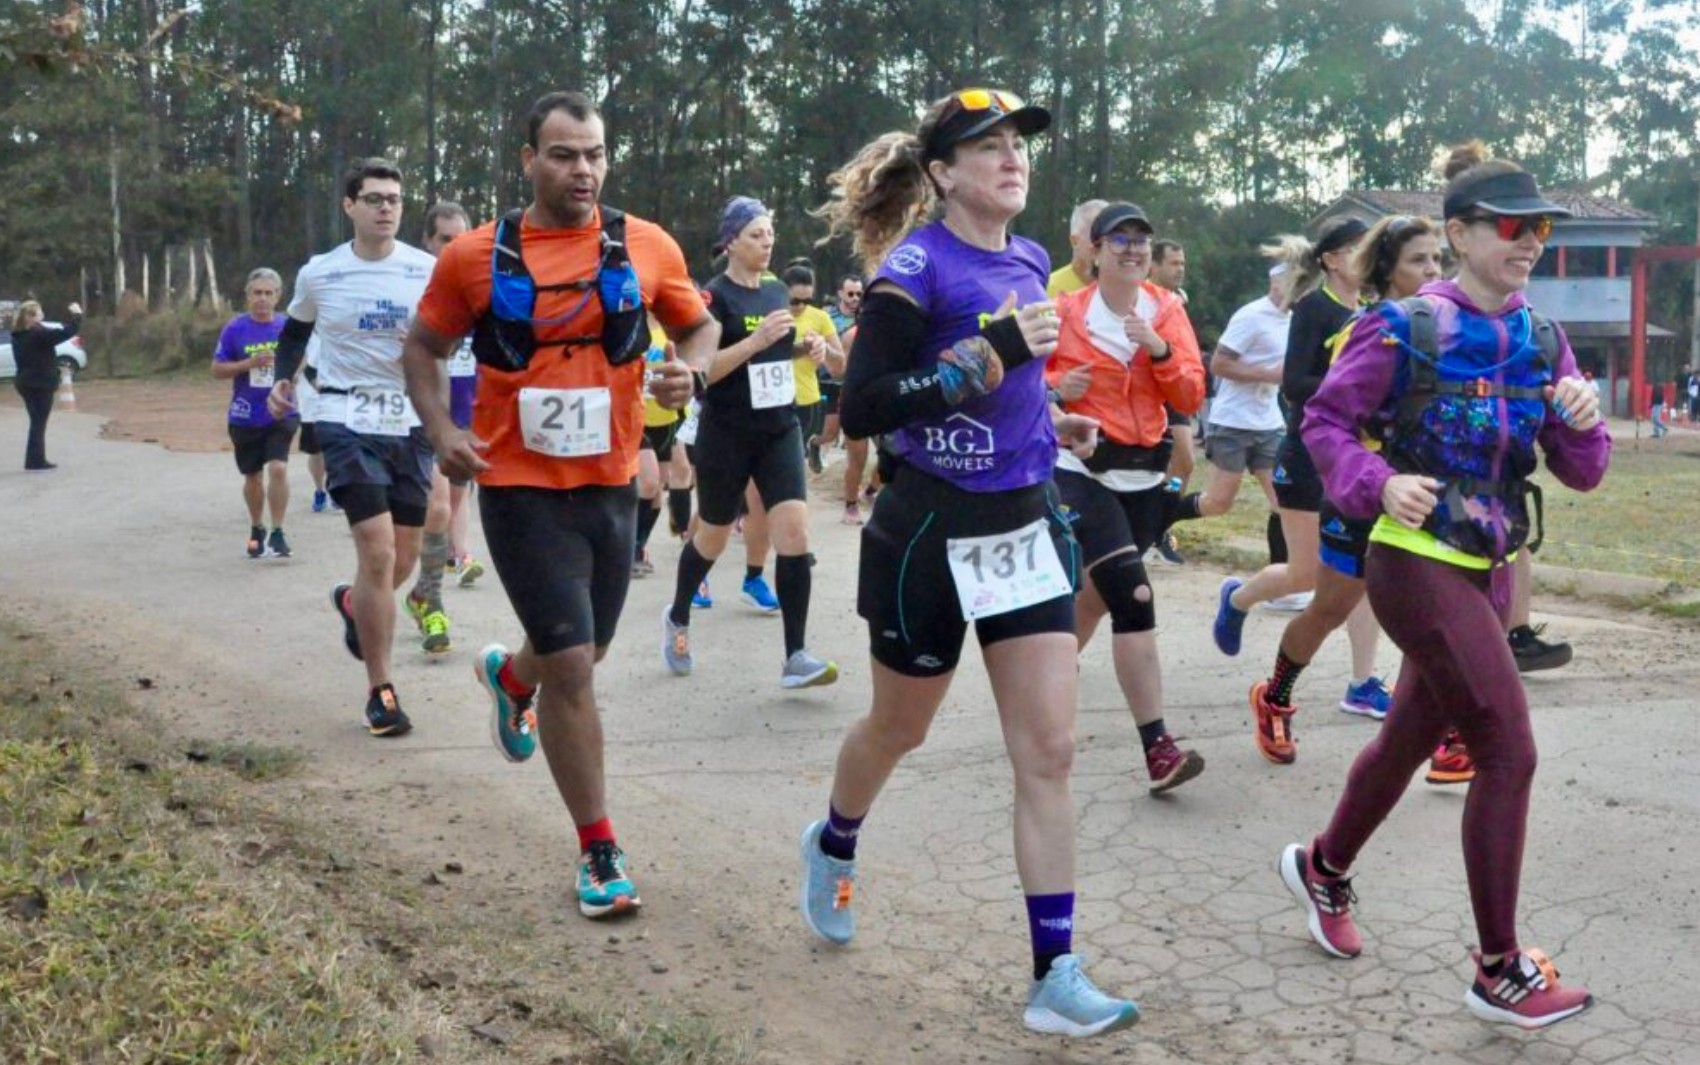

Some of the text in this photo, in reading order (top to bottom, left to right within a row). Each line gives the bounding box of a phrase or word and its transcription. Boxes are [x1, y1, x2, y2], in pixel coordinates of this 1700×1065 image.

[354, 391, 405, 416] 219
[540, 395, 585, 430] 21
[924, 428, 977, 456] BG
[931, 454, 996, 470] MÓVEIS
[961, 529, 1039, 583] 137
